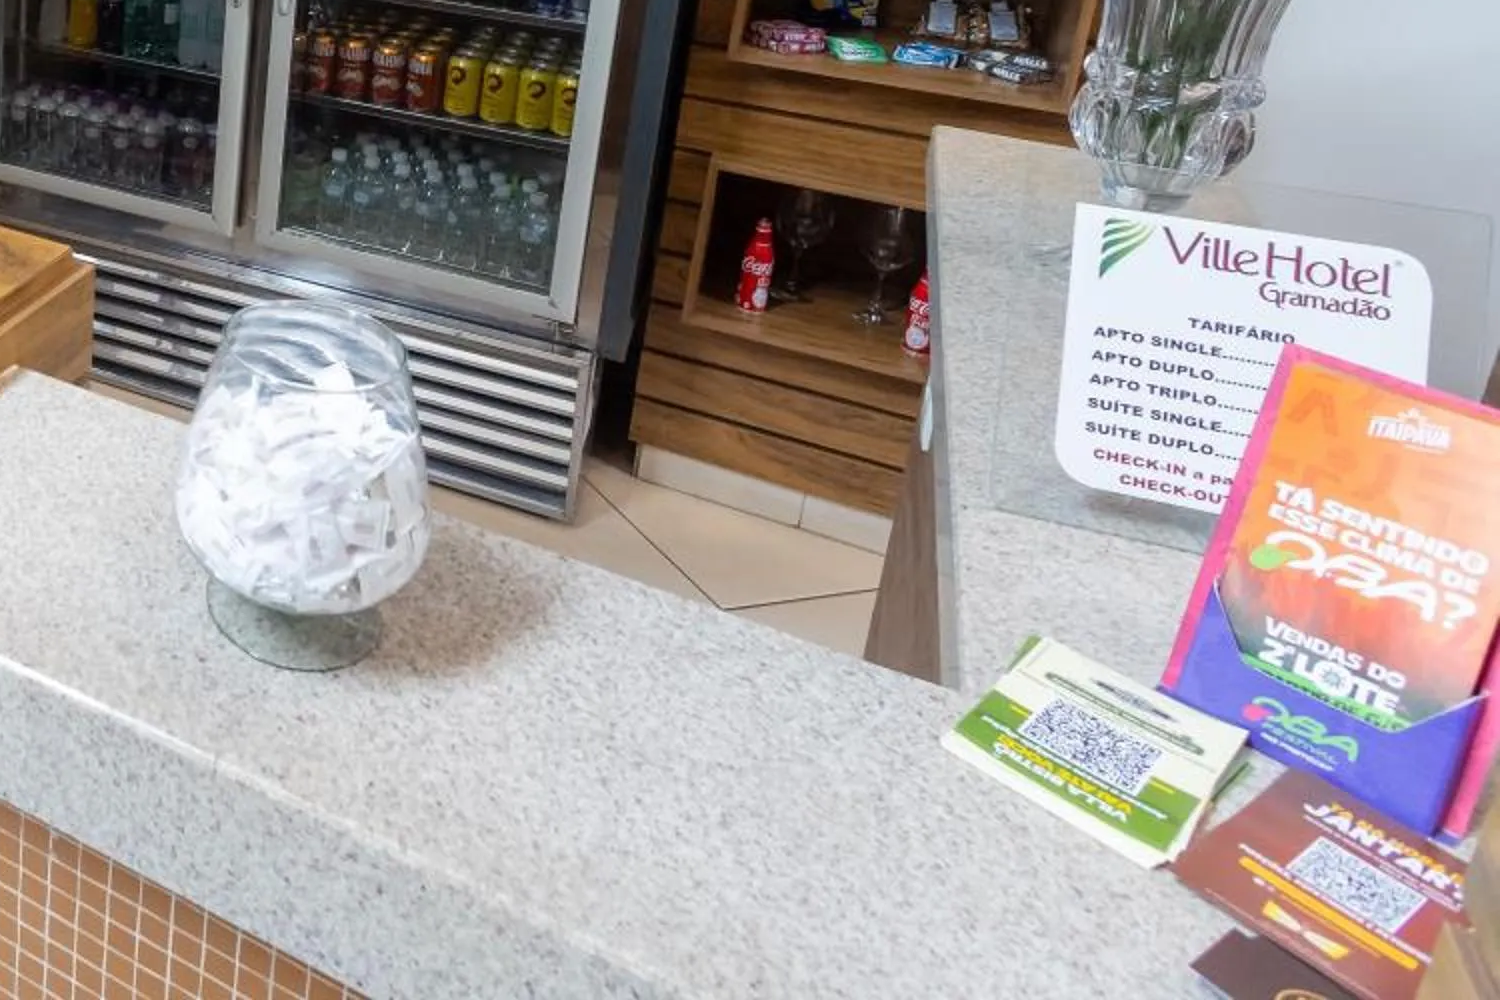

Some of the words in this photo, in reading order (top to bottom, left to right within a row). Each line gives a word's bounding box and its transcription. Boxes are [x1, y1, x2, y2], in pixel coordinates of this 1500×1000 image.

[1265, 241, 1392, 299] Hotel
[1258, 281, 1392, 321] Gramadão
[1093, 326, 1145, 344] APTO
[1188, 317, 1297, 344] TARIFÁRIO
[1091, 350, 1143, 368] APTO
[1089, 373, 1141, 391] APTO
[1087, 397, 1144, 417] SUÍTE
[1084, 421, 1142, 441] SUÍTE
[1092, 448, 1187, 477] CHECK-IN
[1118, 474, 1230, 505] CHECK-OU
[1268, 503, 1338, 540] ESSE
[1339, 528, 1436, 578] CLIMA
[1440, 566, 1482, 596] DE
[1318, 498, 1489, 575] SENTINDO
[1266, 615, 1364, 671] VENDAS
[1367, 661, 1407, 690] DO
[1293, 652, 1402, 716] LOTE
